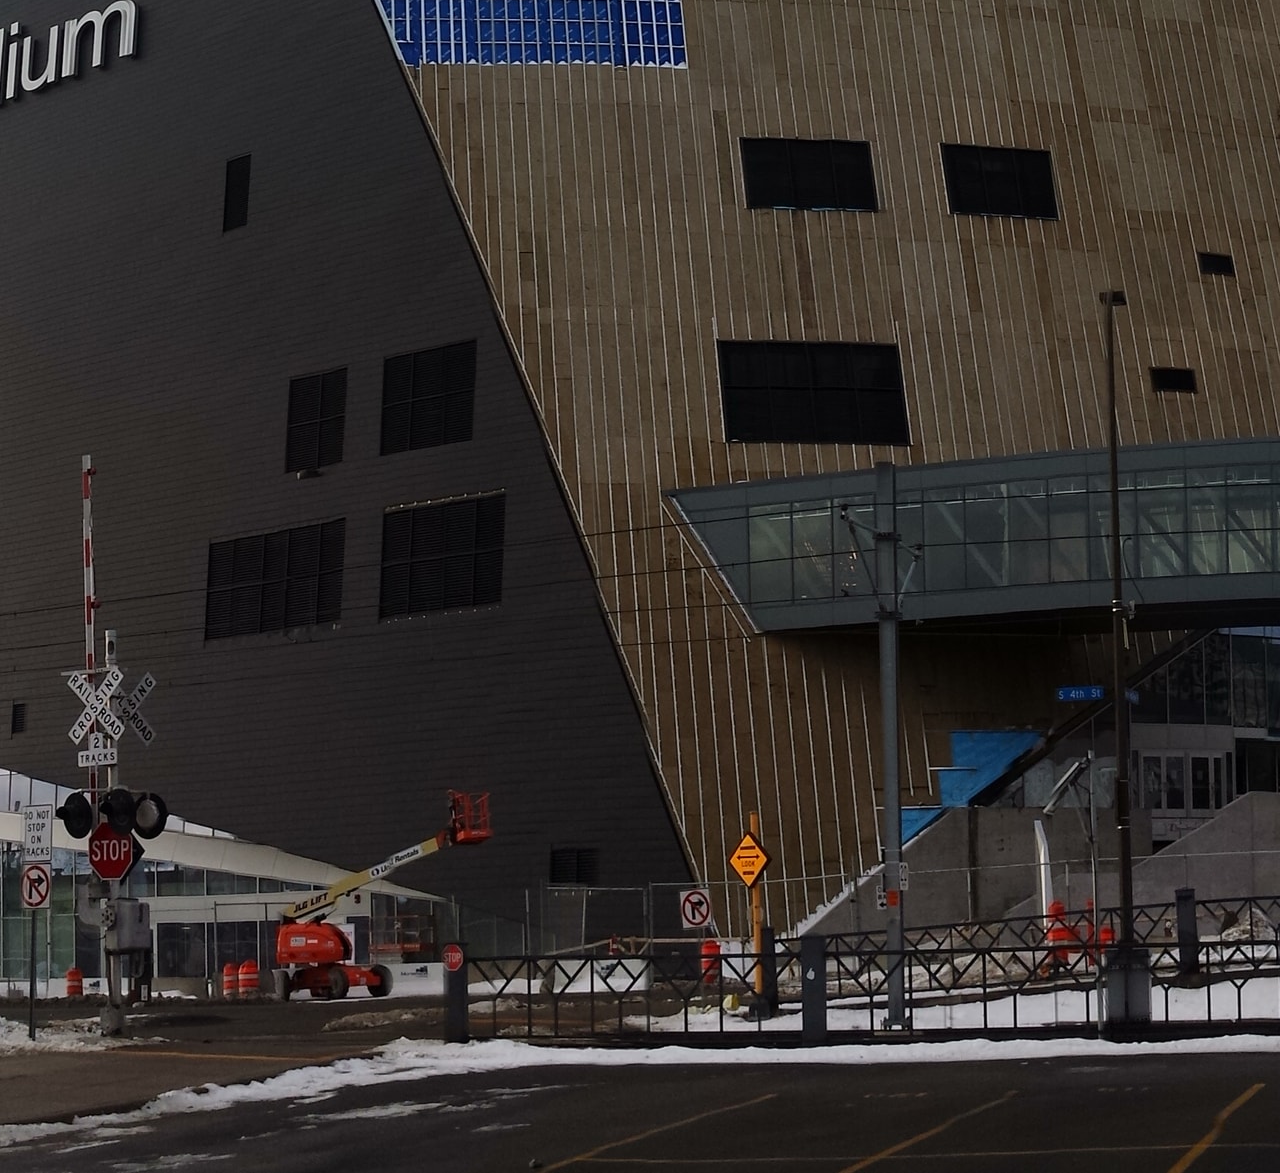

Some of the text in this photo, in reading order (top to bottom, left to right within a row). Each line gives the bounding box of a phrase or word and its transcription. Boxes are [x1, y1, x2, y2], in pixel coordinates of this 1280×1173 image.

[1058, 688, 1101, 700] S 4th St
[93, 737, 100, 748] 2
[80, 752, 115, 764] TRACKS
[36, 810, 50, 820] NOT
[27, 823, 46, 832] STOP
[30, 835, 42, 844] ON
[91, 839, 130, 861] STOP
[293, 892, 329, 913] JLG LIFT
[443, 952, 461, 963] STOP
